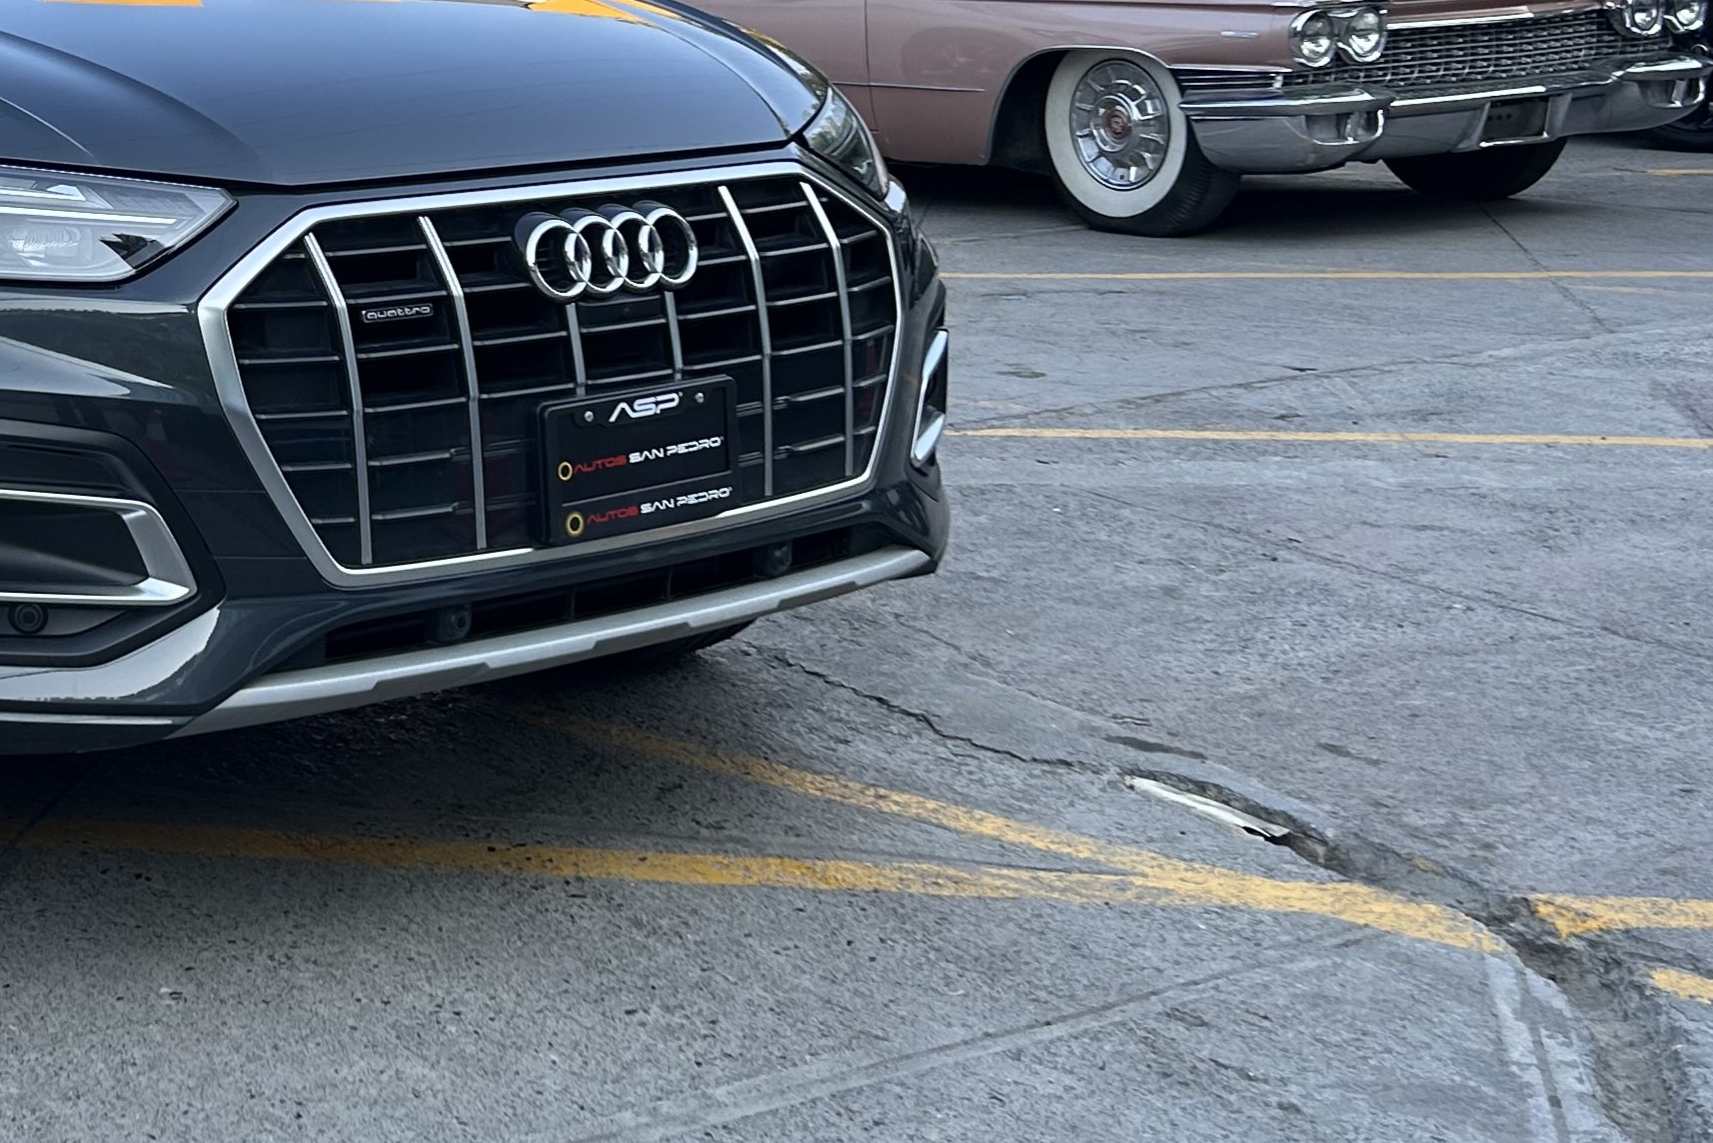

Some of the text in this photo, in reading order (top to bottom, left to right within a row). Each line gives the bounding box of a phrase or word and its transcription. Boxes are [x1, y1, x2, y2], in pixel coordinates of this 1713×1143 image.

[367, 305, 431, 320] quattro
[608, 392, 680, 423] ASP
[573, 436, 723, 474] AUTOS SAN PEDRO
[587, 487, 732, 525] AUTOS SAN PEDRO
